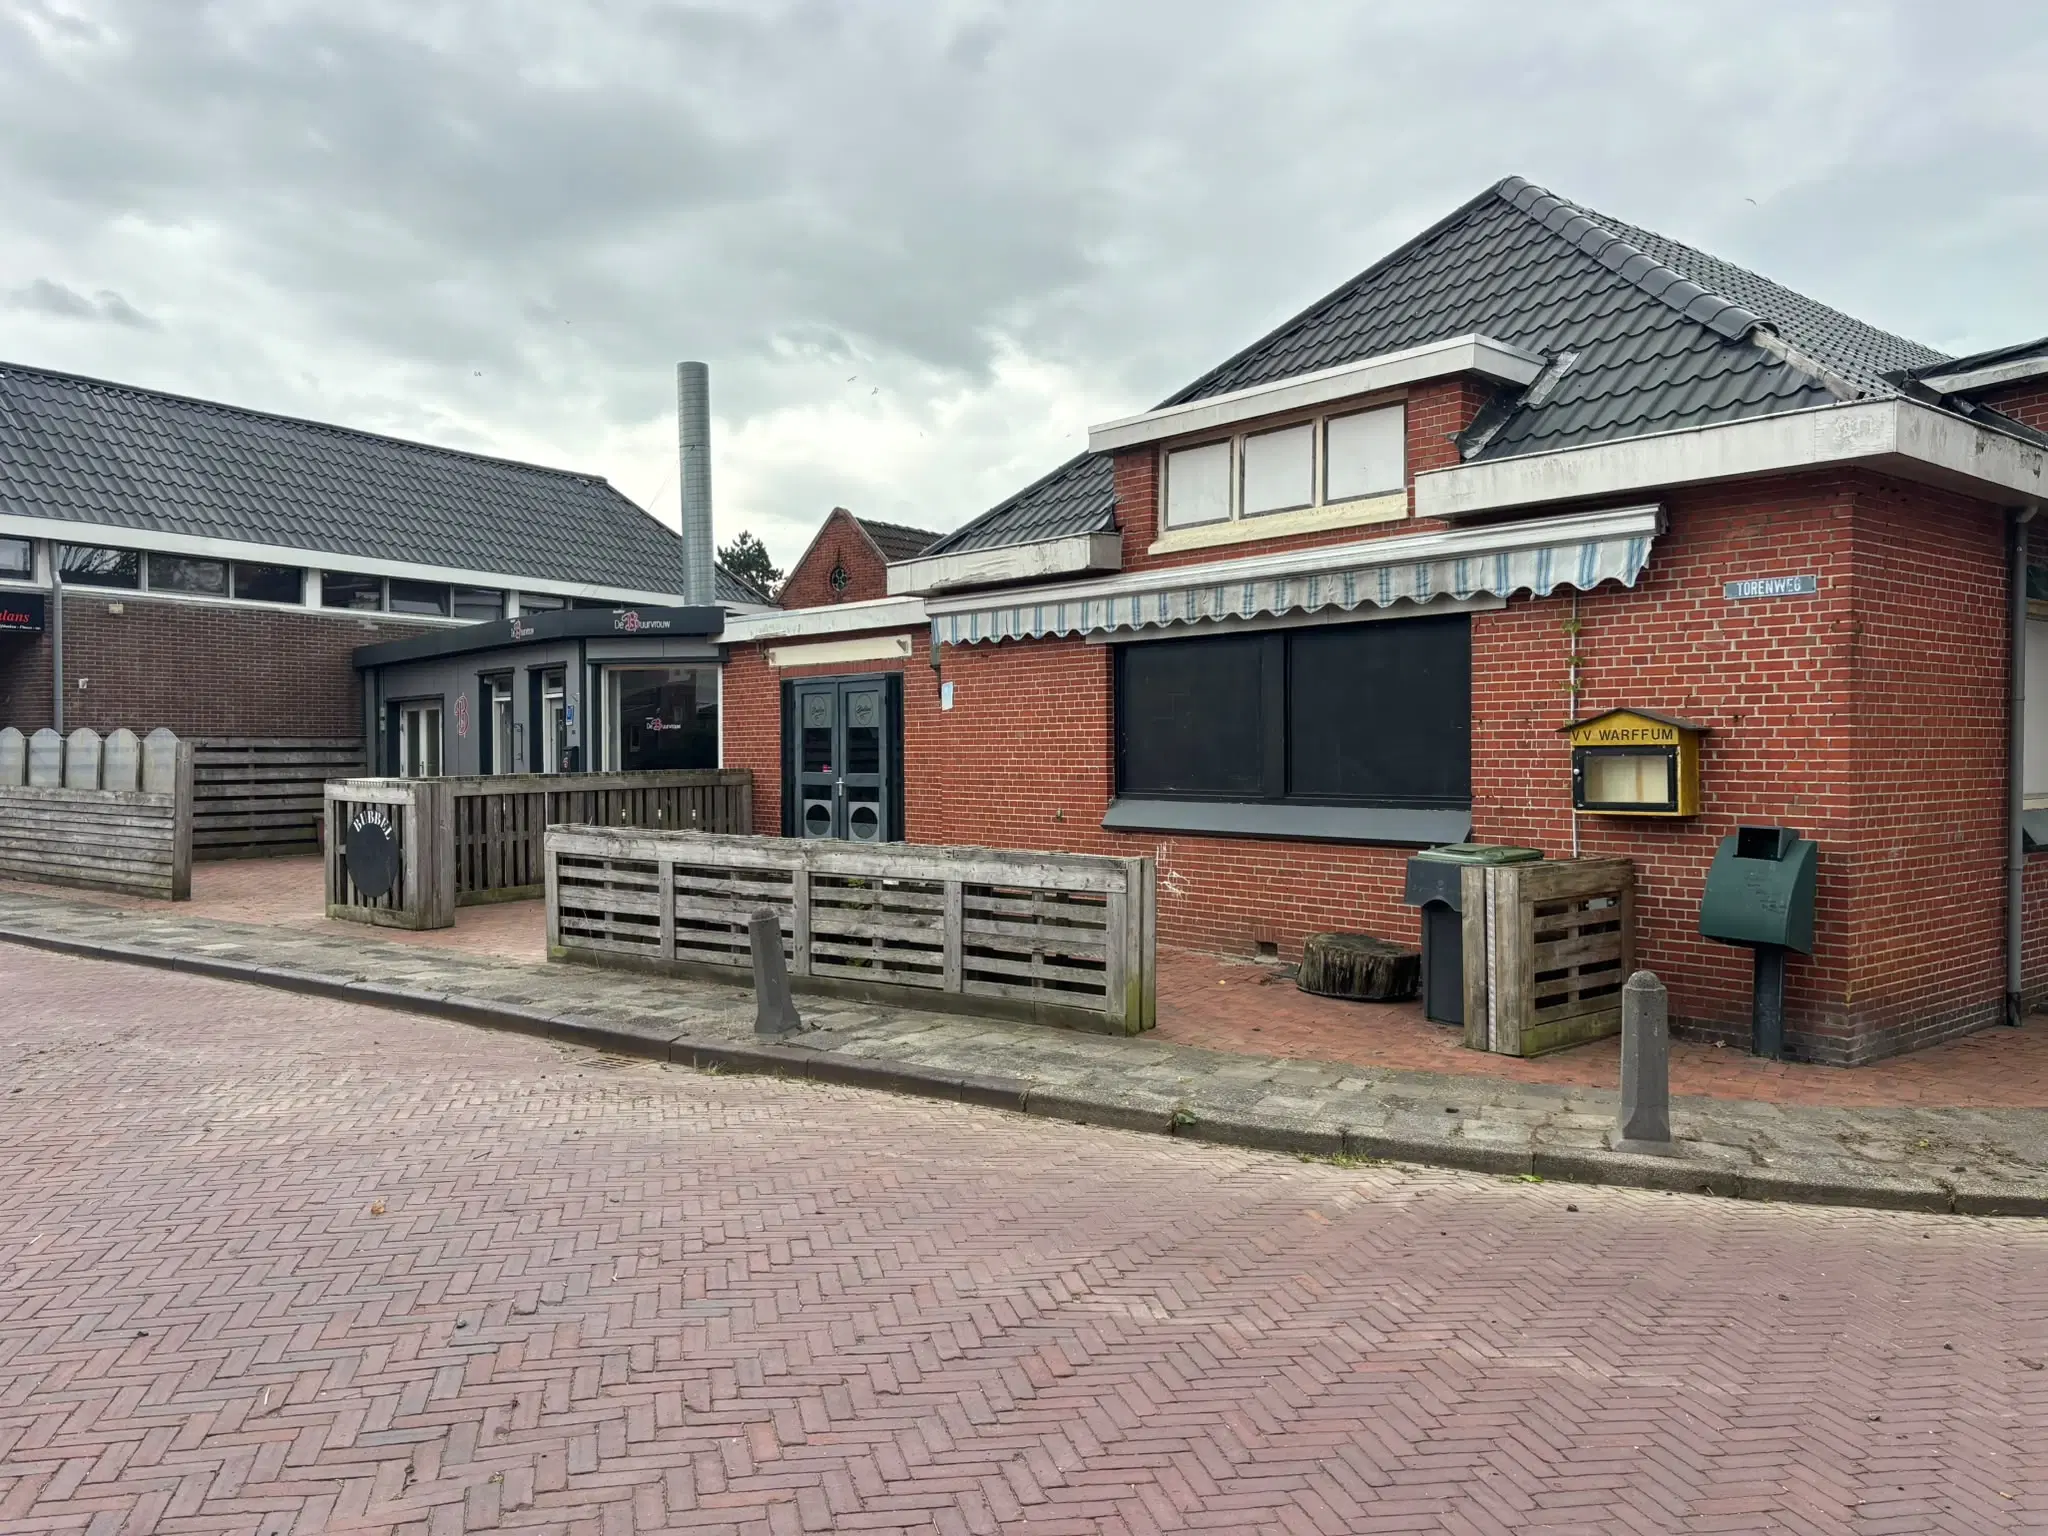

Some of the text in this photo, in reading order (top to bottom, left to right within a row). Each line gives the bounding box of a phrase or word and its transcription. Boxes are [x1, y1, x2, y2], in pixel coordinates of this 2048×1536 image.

[1736, 577, 1801, 596] TORENWEG
[614, 610, 671, 632] De Buurvrouw
[1599, 728, 1673, 741] WARFFUM
[353, 810, 392, 840] BUBBEL
